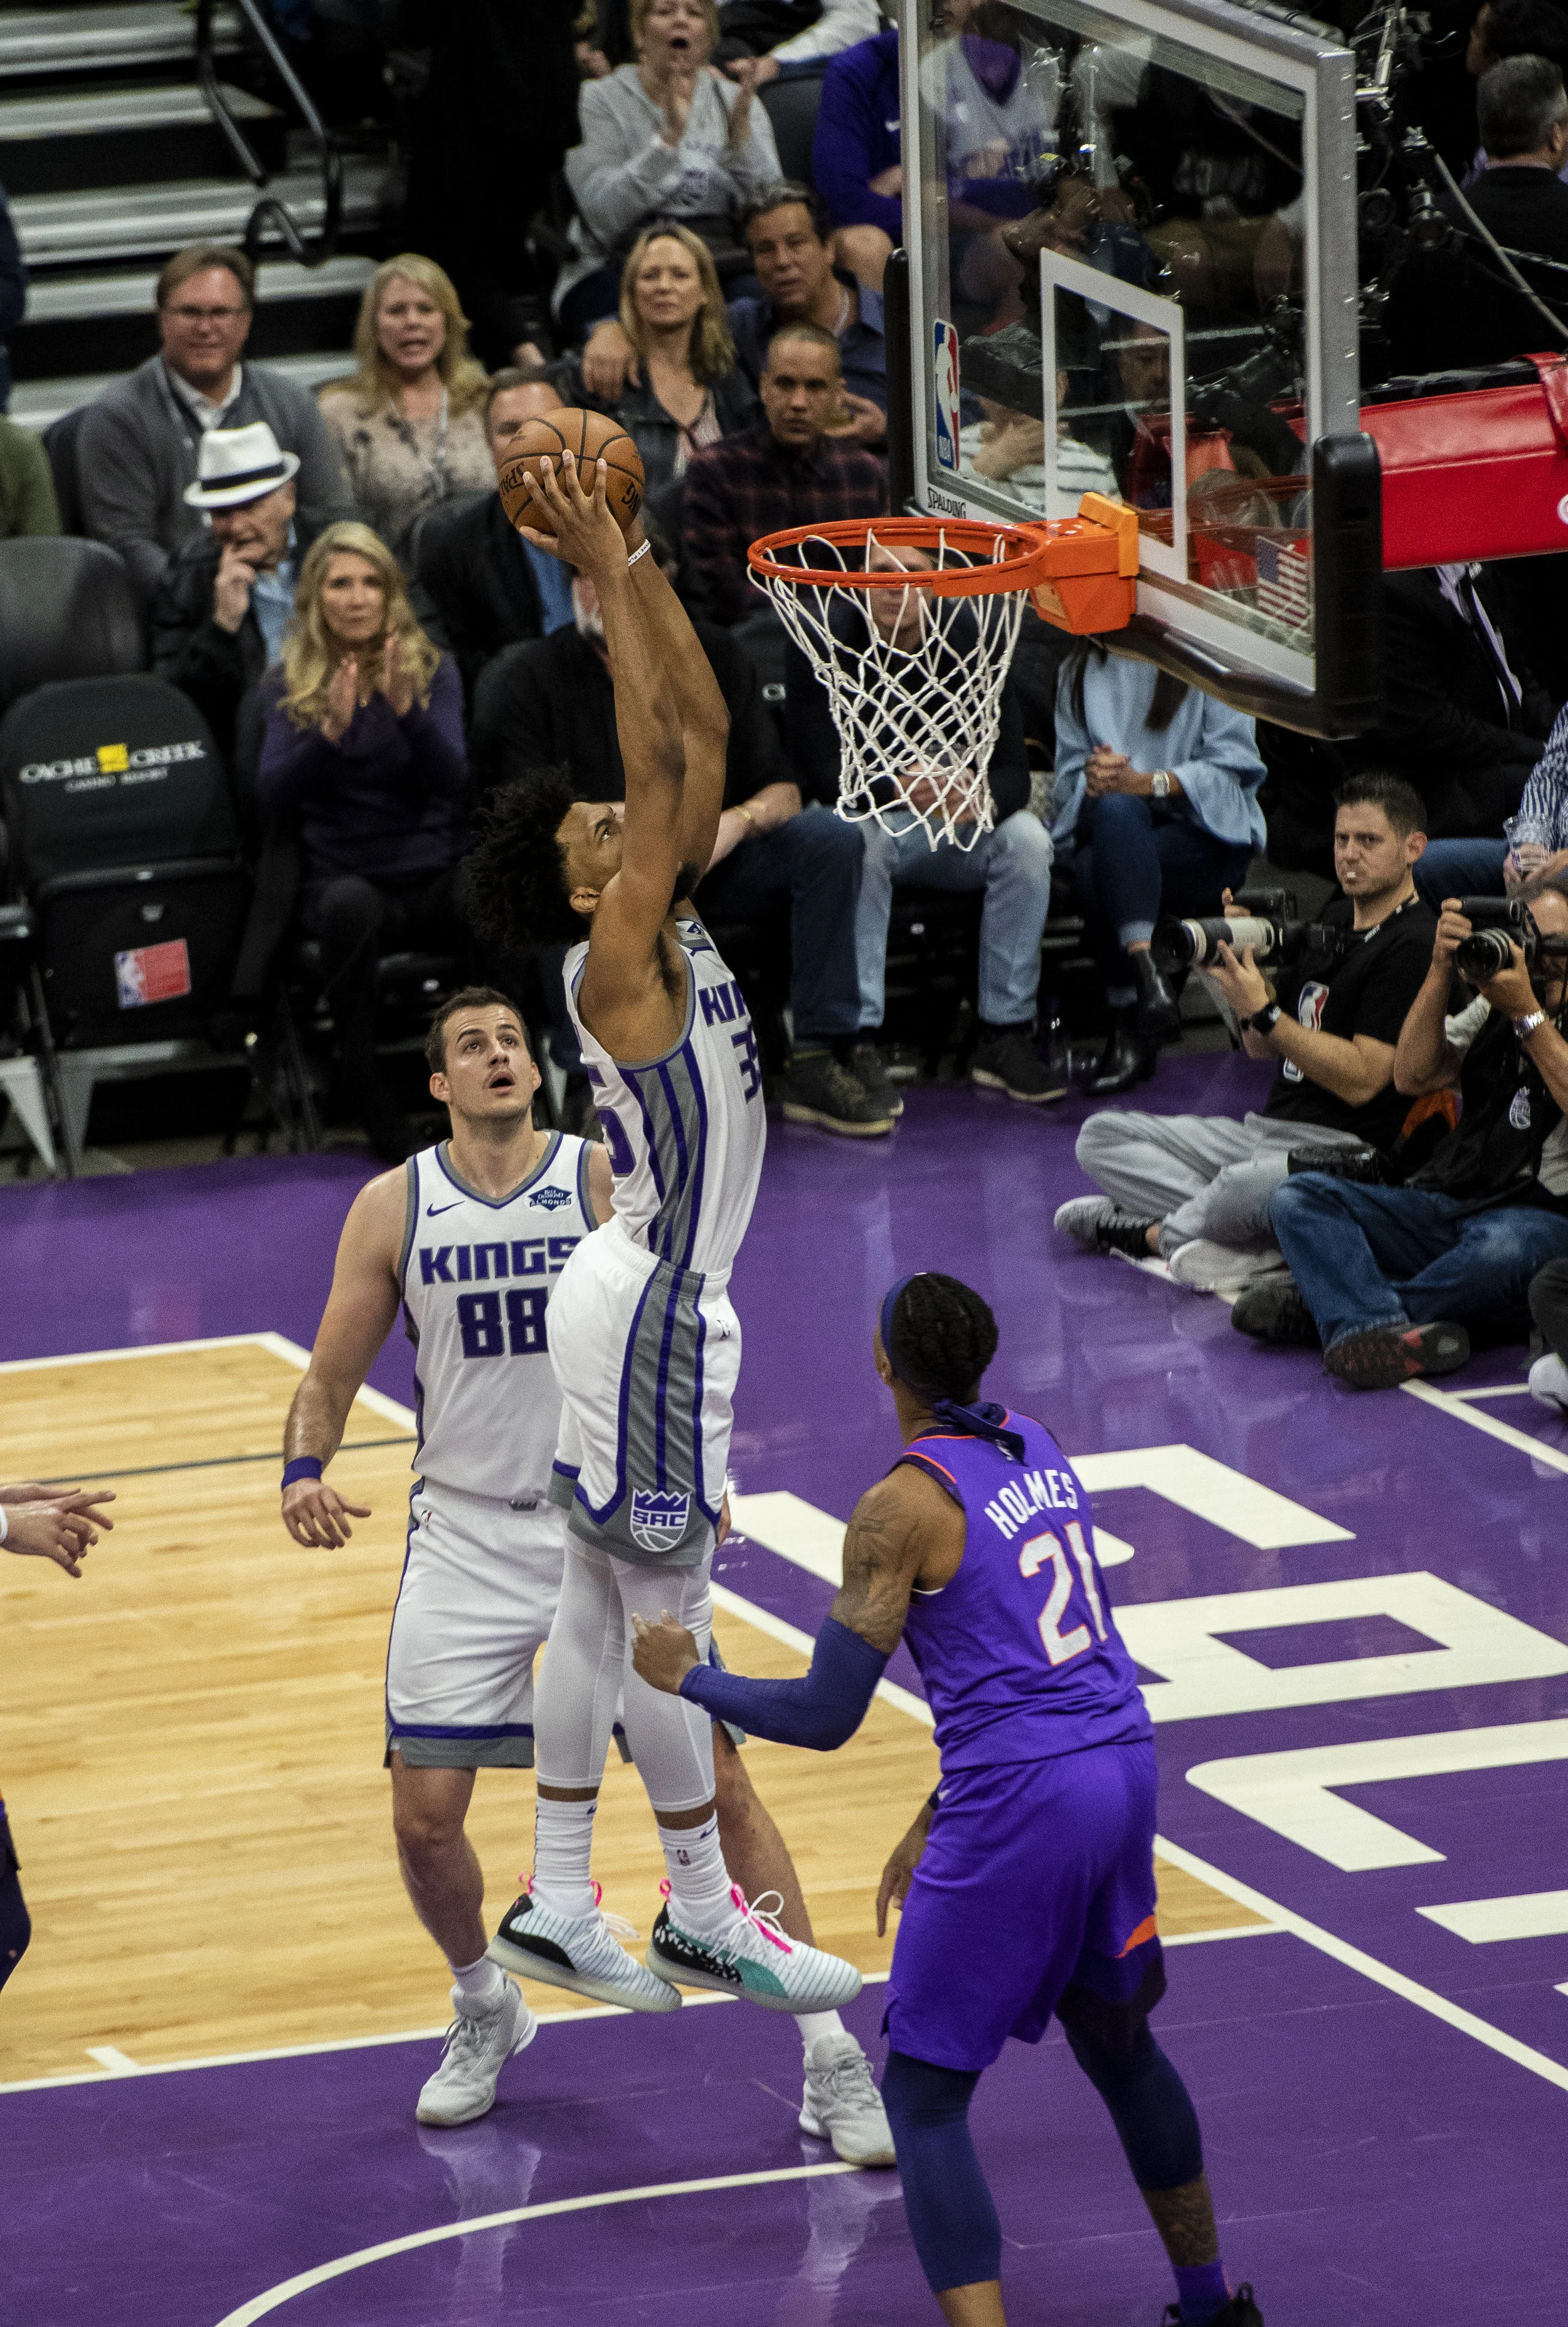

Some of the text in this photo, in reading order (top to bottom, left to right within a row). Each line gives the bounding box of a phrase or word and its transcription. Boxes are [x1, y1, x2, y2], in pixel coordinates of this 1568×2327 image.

[928, 486, 967, 519] SPALDING
[531, 1198, 571, 1206] ALMONDS
[419, 1235, 582, 1286] KINGS
[456, 1286, 549, 1358] 88
[632, 1509, 687, 1527] SAC
[984, 1469, 1078, 1540] HOLMES
[1018, 1520, 1108, 1666] 21
